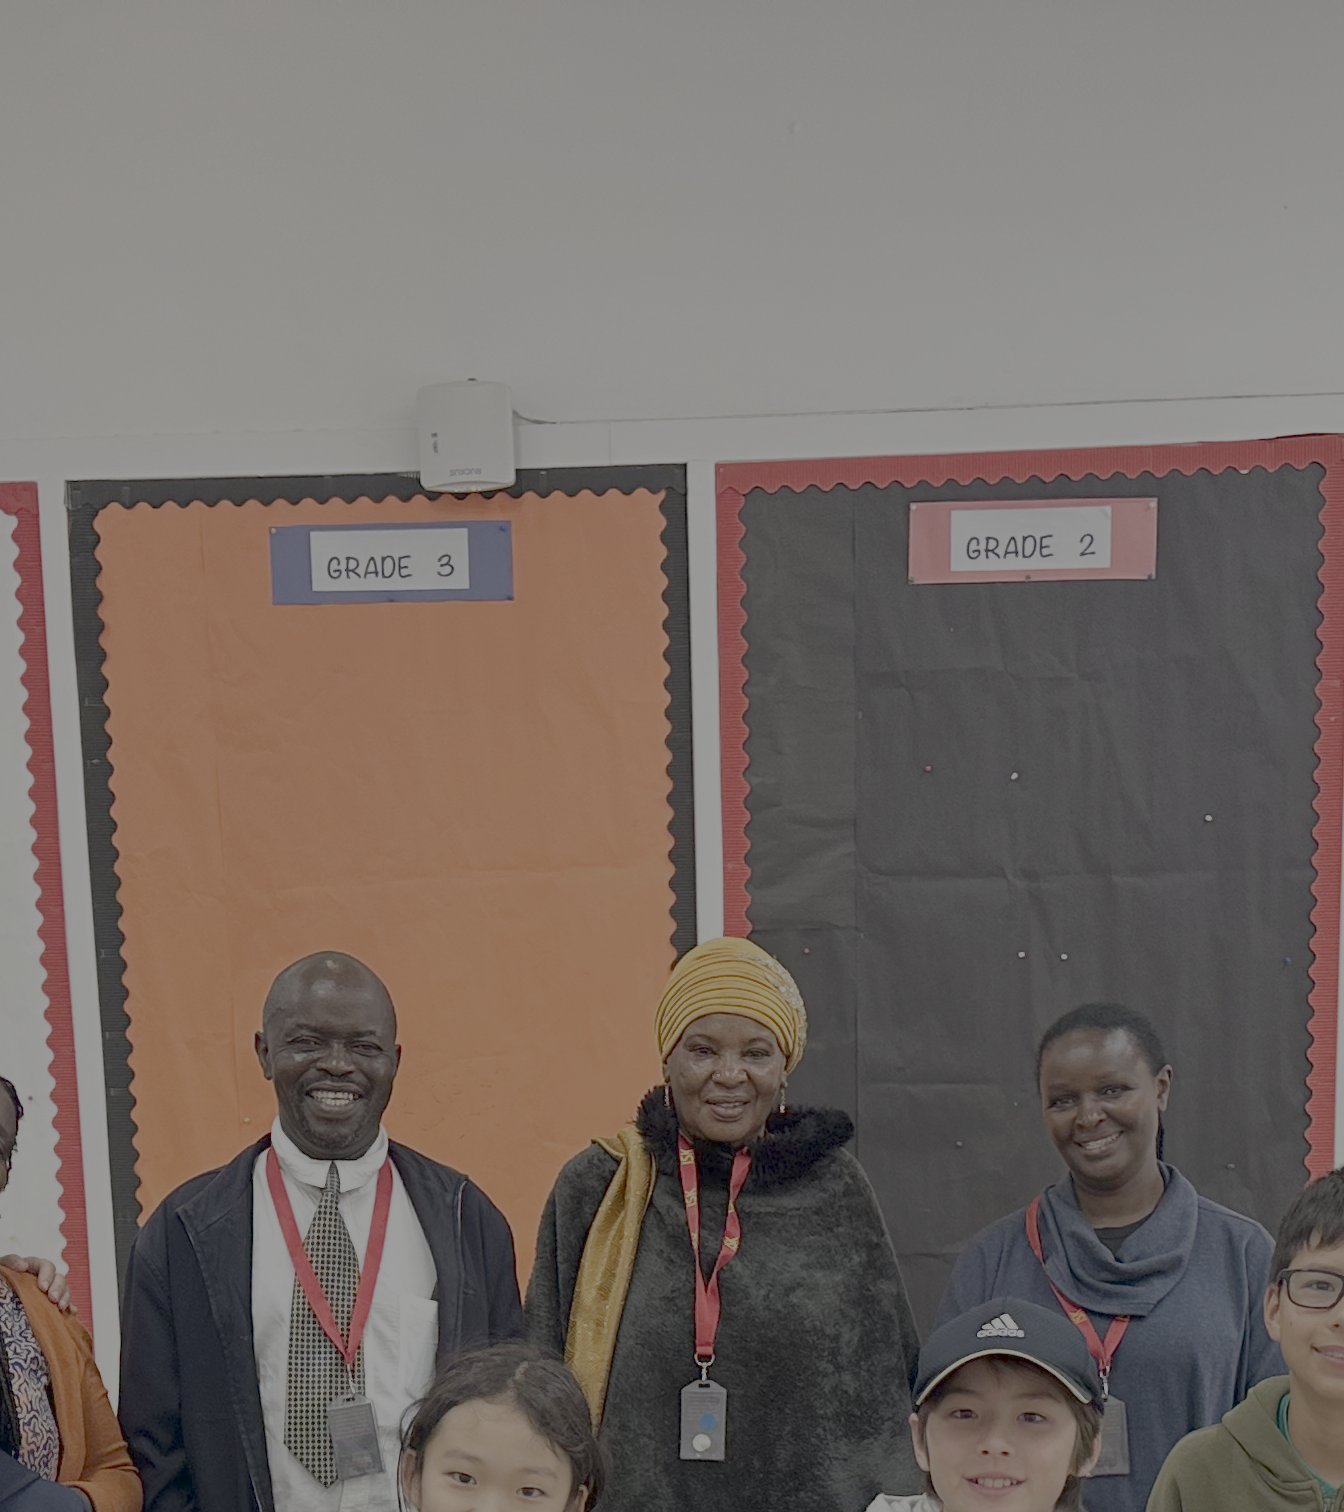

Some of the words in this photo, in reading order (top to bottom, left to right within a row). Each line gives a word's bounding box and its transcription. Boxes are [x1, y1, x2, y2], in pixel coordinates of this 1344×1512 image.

[966, 534, 1054, 560] GRADE
[1079, 533, 1096, 557] 2
[327, 555, 413, 580] GRADE
[436, 553, 455, 578] 3
[680, 1148, 695, 1165] ISK
[684, 1187, 697, 1208] ISK
